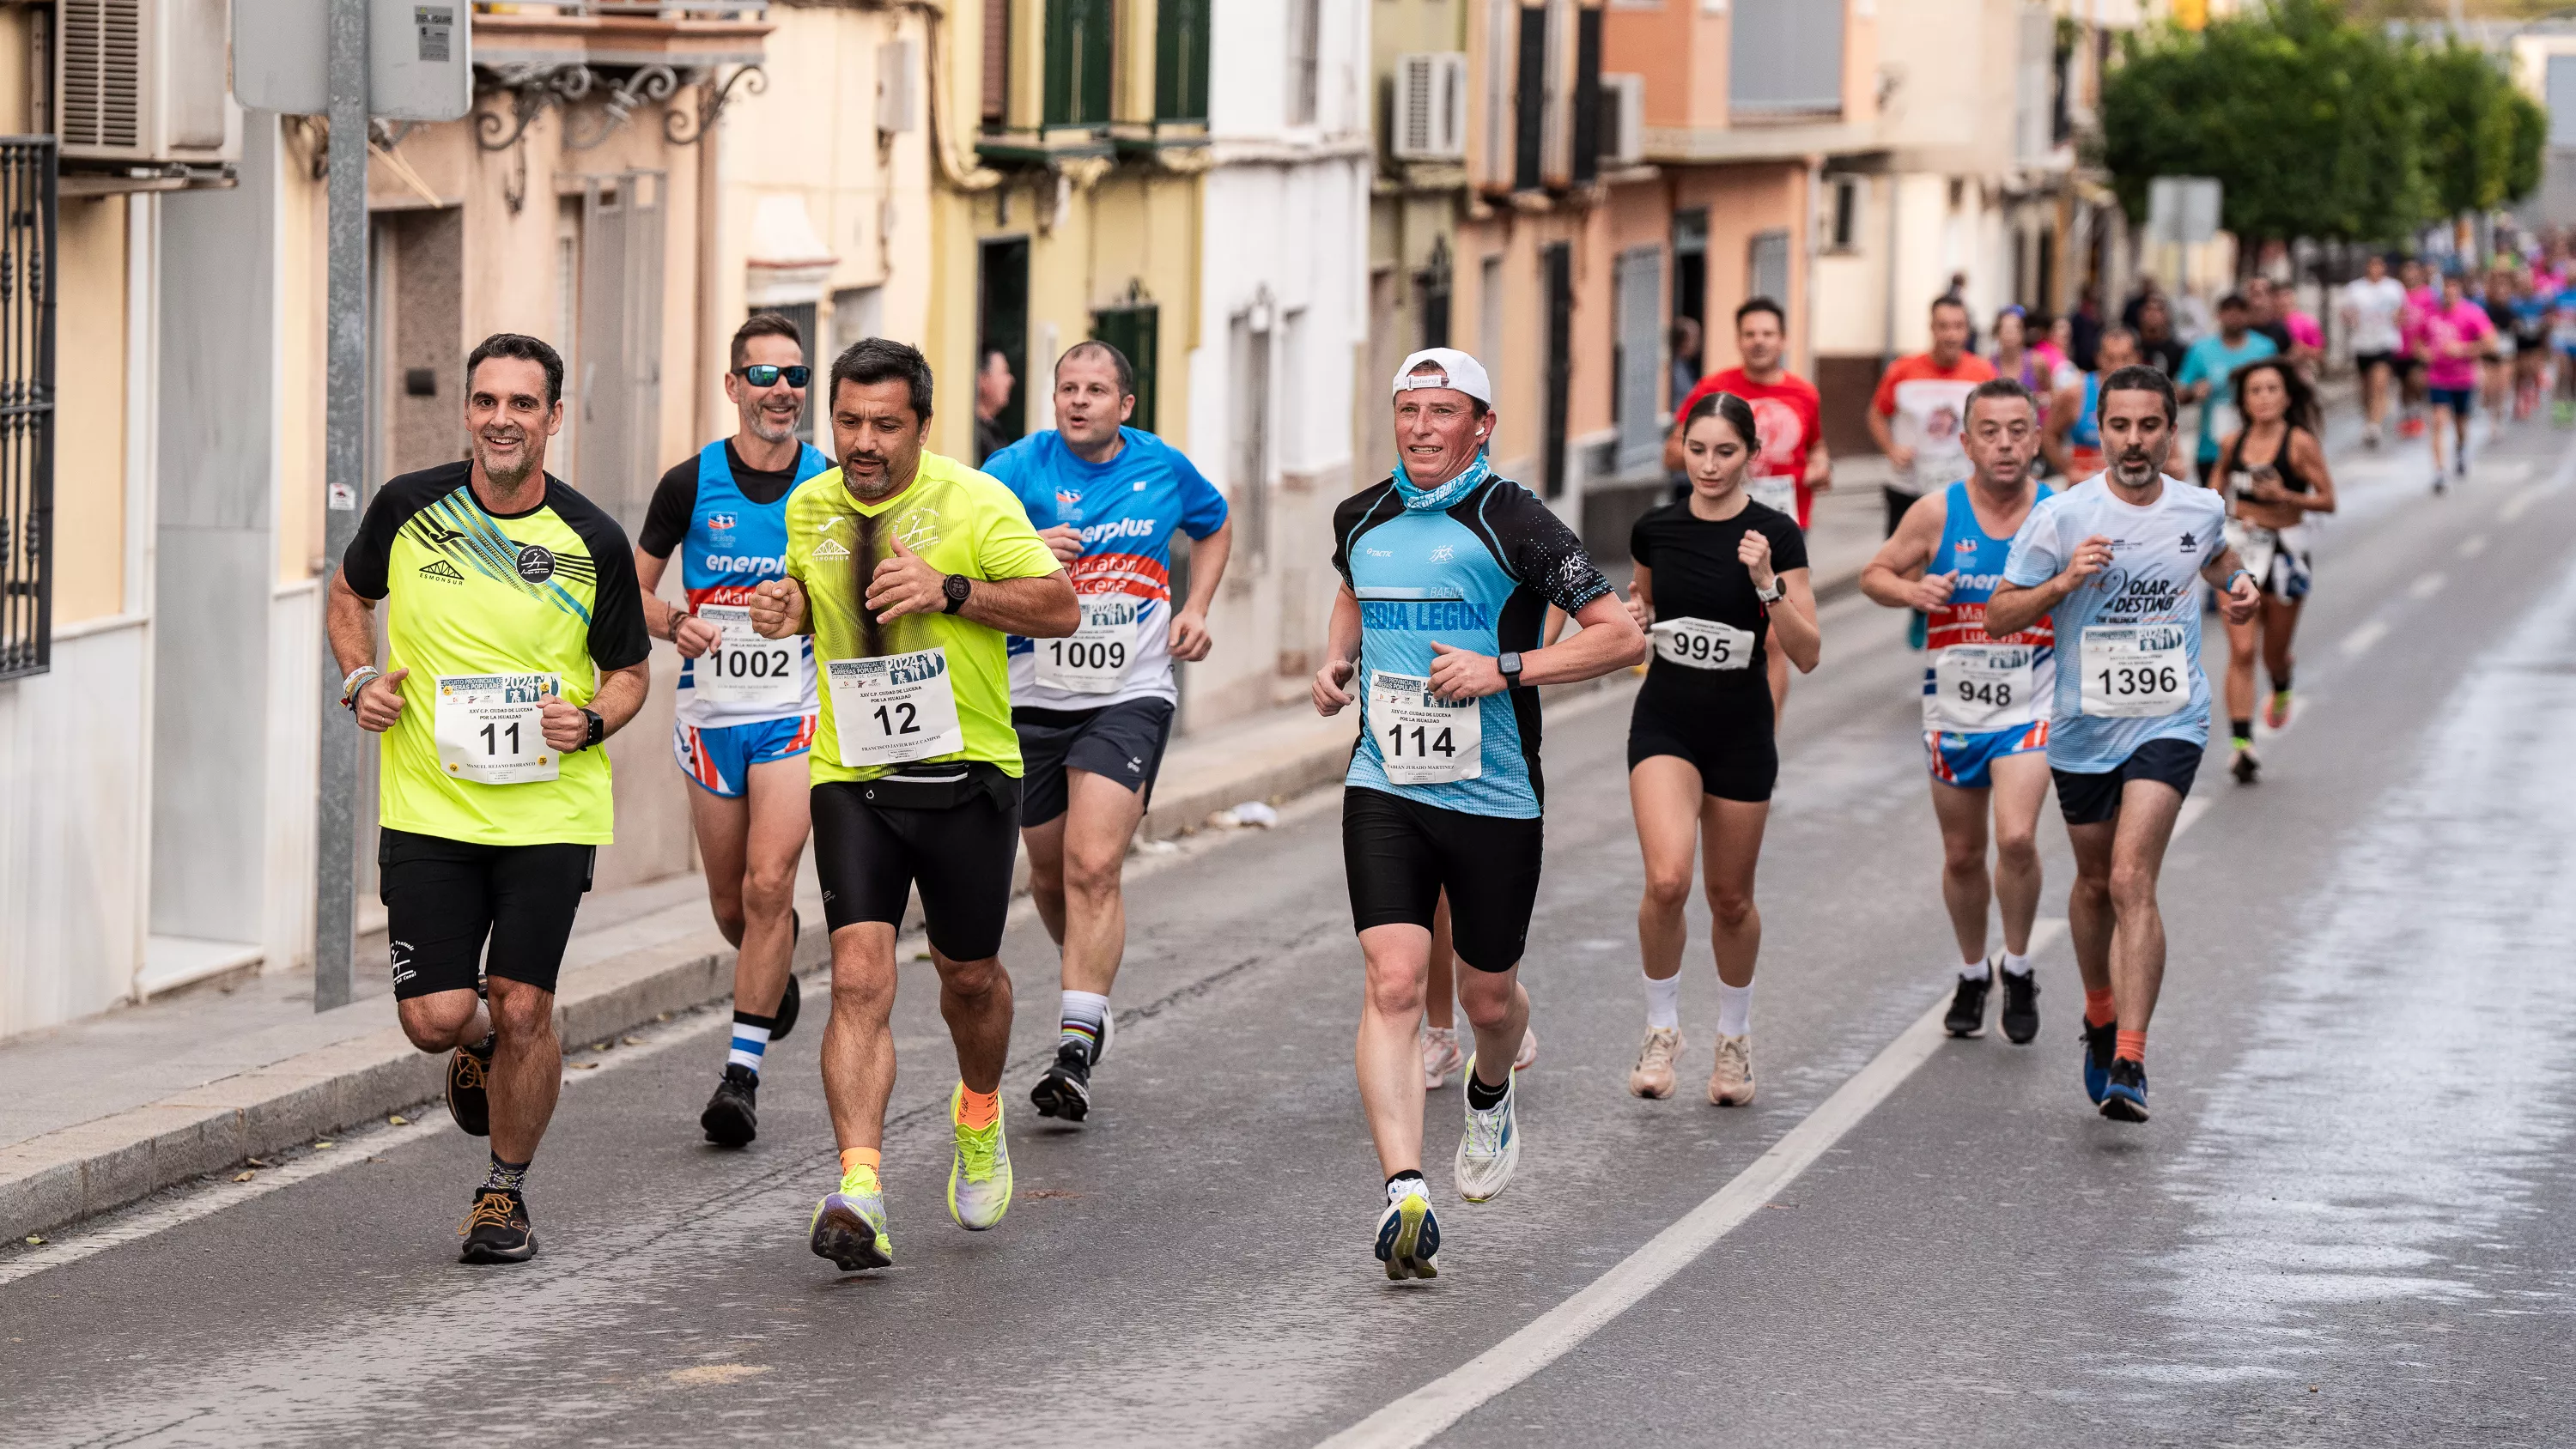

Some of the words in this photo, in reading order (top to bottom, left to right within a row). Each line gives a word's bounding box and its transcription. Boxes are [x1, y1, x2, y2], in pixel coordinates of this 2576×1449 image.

[1082, 517, 1155, 543] erplus
[419, 573, 463, 586] ESMONSUR
[1074, 579, 1127, 593] ucena
[1430, 587, 1465, 598] BAENA
[2114, 597, 2175, 613] DESTINO
[1417, 603, 1491, 631] LEGUA
[1049, 640, 1125, 669] 1009
[1674, 632, 1730, 664] 995
[710, 649, 789, 677] 1002
[886, 655, 920, 670] 2024
[505, 676, 534, 689] 2024
[1393, 684, 1422, 693] POPULARES
[2099, 666, 2178, 695] 1396
[1959, 681, 2011, 706] 948
[873, 702, 920, 736] 12
[480, 722, 519, 755] 11
[920, 735, 941, 744] CAMPOS
[1388, 724, 1455, 757] 114
